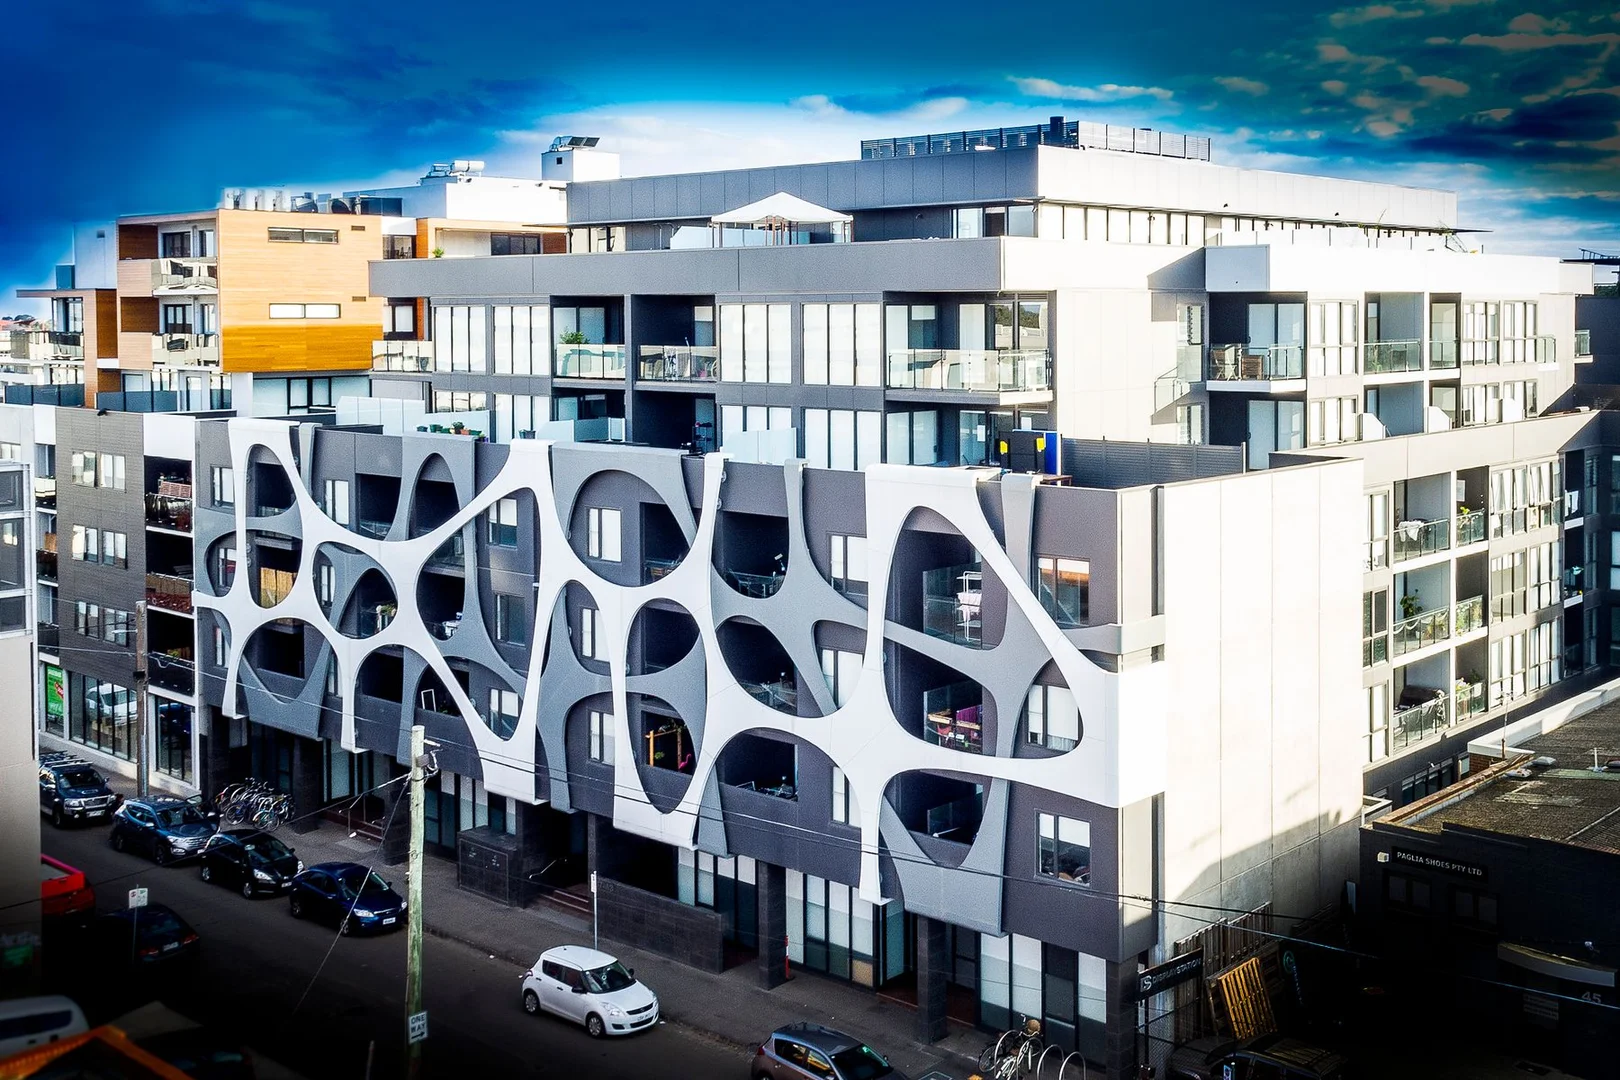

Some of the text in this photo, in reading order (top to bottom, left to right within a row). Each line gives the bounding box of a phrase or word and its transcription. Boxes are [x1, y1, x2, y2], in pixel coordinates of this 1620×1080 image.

[1397, 852, 1483, 876] PAGLIA SHOES PTY LTD
[1581, 990, 1602, 1004] 45
[411, 1014, 425, 1024] ONE
[411, 1023, 425, 1033] WAY
